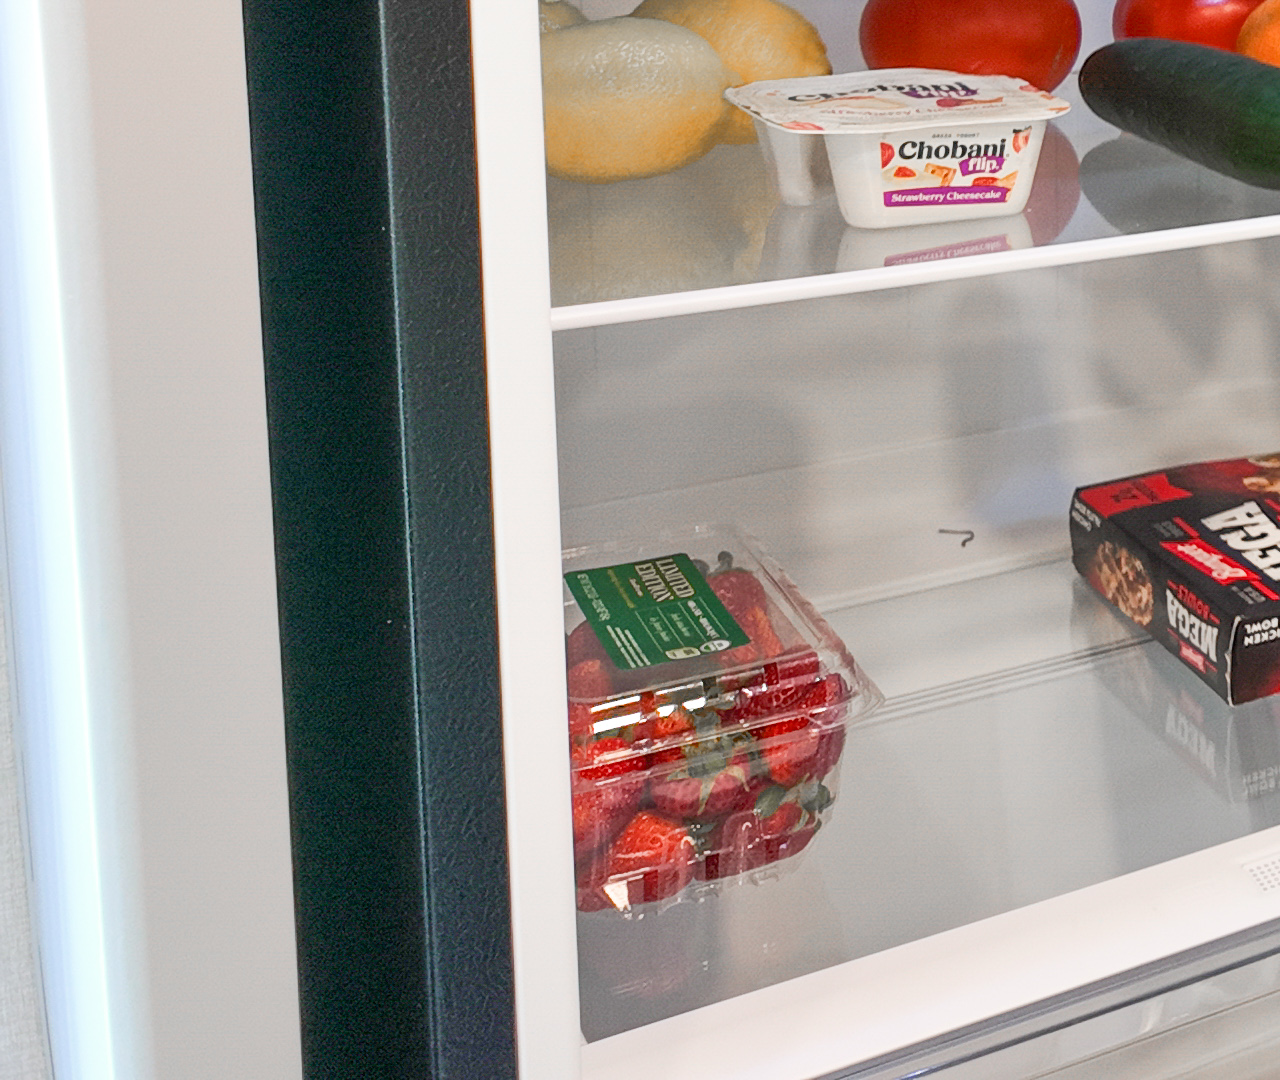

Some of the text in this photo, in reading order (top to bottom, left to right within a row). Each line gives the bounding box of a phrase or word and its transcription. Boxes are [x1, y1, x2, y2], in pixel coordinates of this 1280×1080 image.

[898, 139, 1007, 160] Chobani
[890, 190, 1002, 203] Strawberry Cheesecake
[634, 562, 675, 603] EDITION
[654, 557, 696, 599] LIMITED
[1165, 588, 1219, 663] MEGA
[1243, 613, 1280, 634] BOWL
